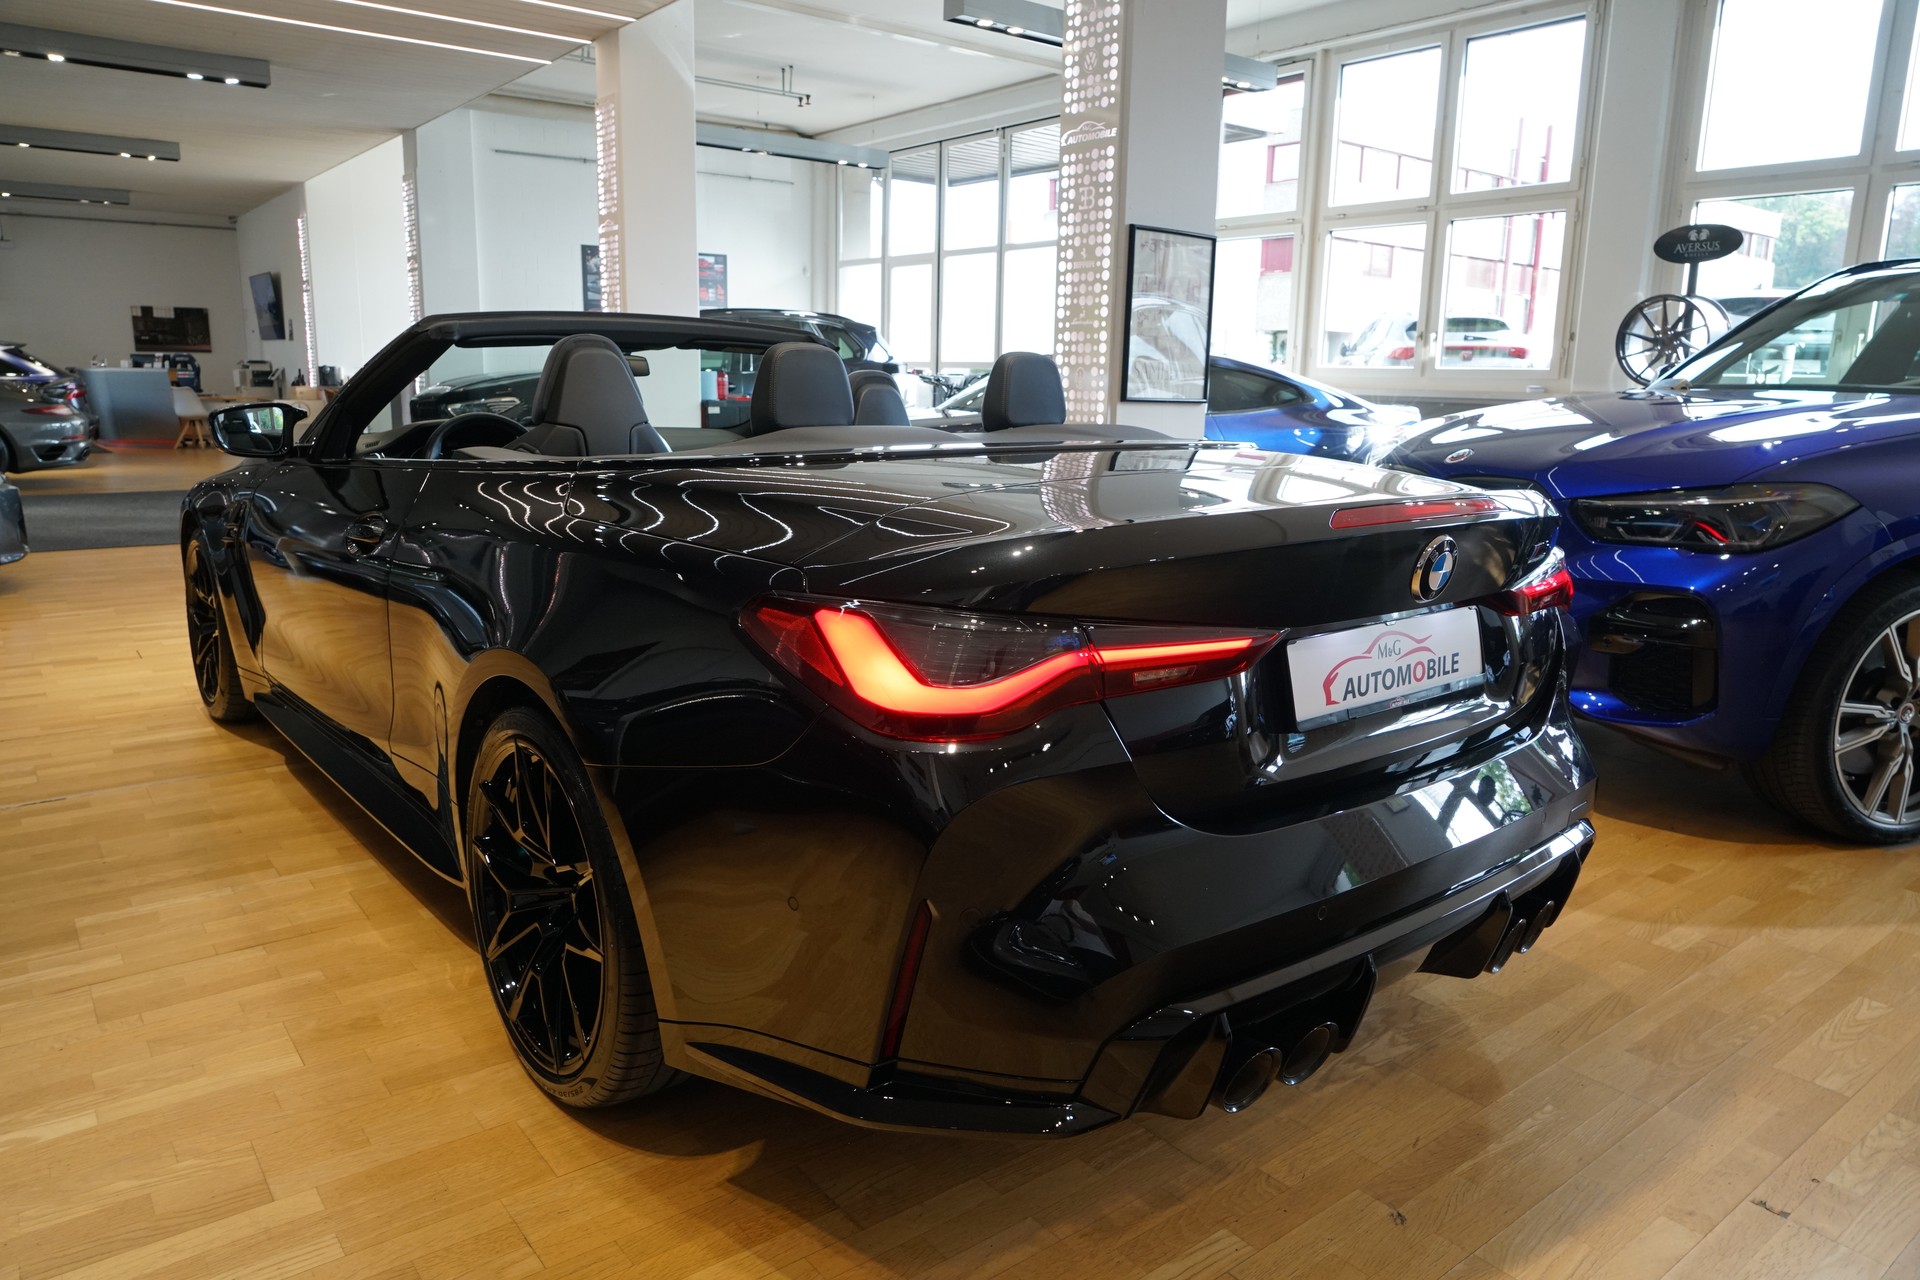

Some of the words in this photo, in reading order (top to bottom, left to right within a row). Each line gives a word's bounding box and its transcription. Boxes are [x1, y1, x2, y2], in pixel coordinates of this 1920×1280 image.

[1067, 127, 1118, 145] AUTOMOBILE
[1673, 240, 1720, 254] AVERSUS
[1377, 639, 1401, 660] M&G
[1342, 652, 1459, 701] AUTOMOBILE
